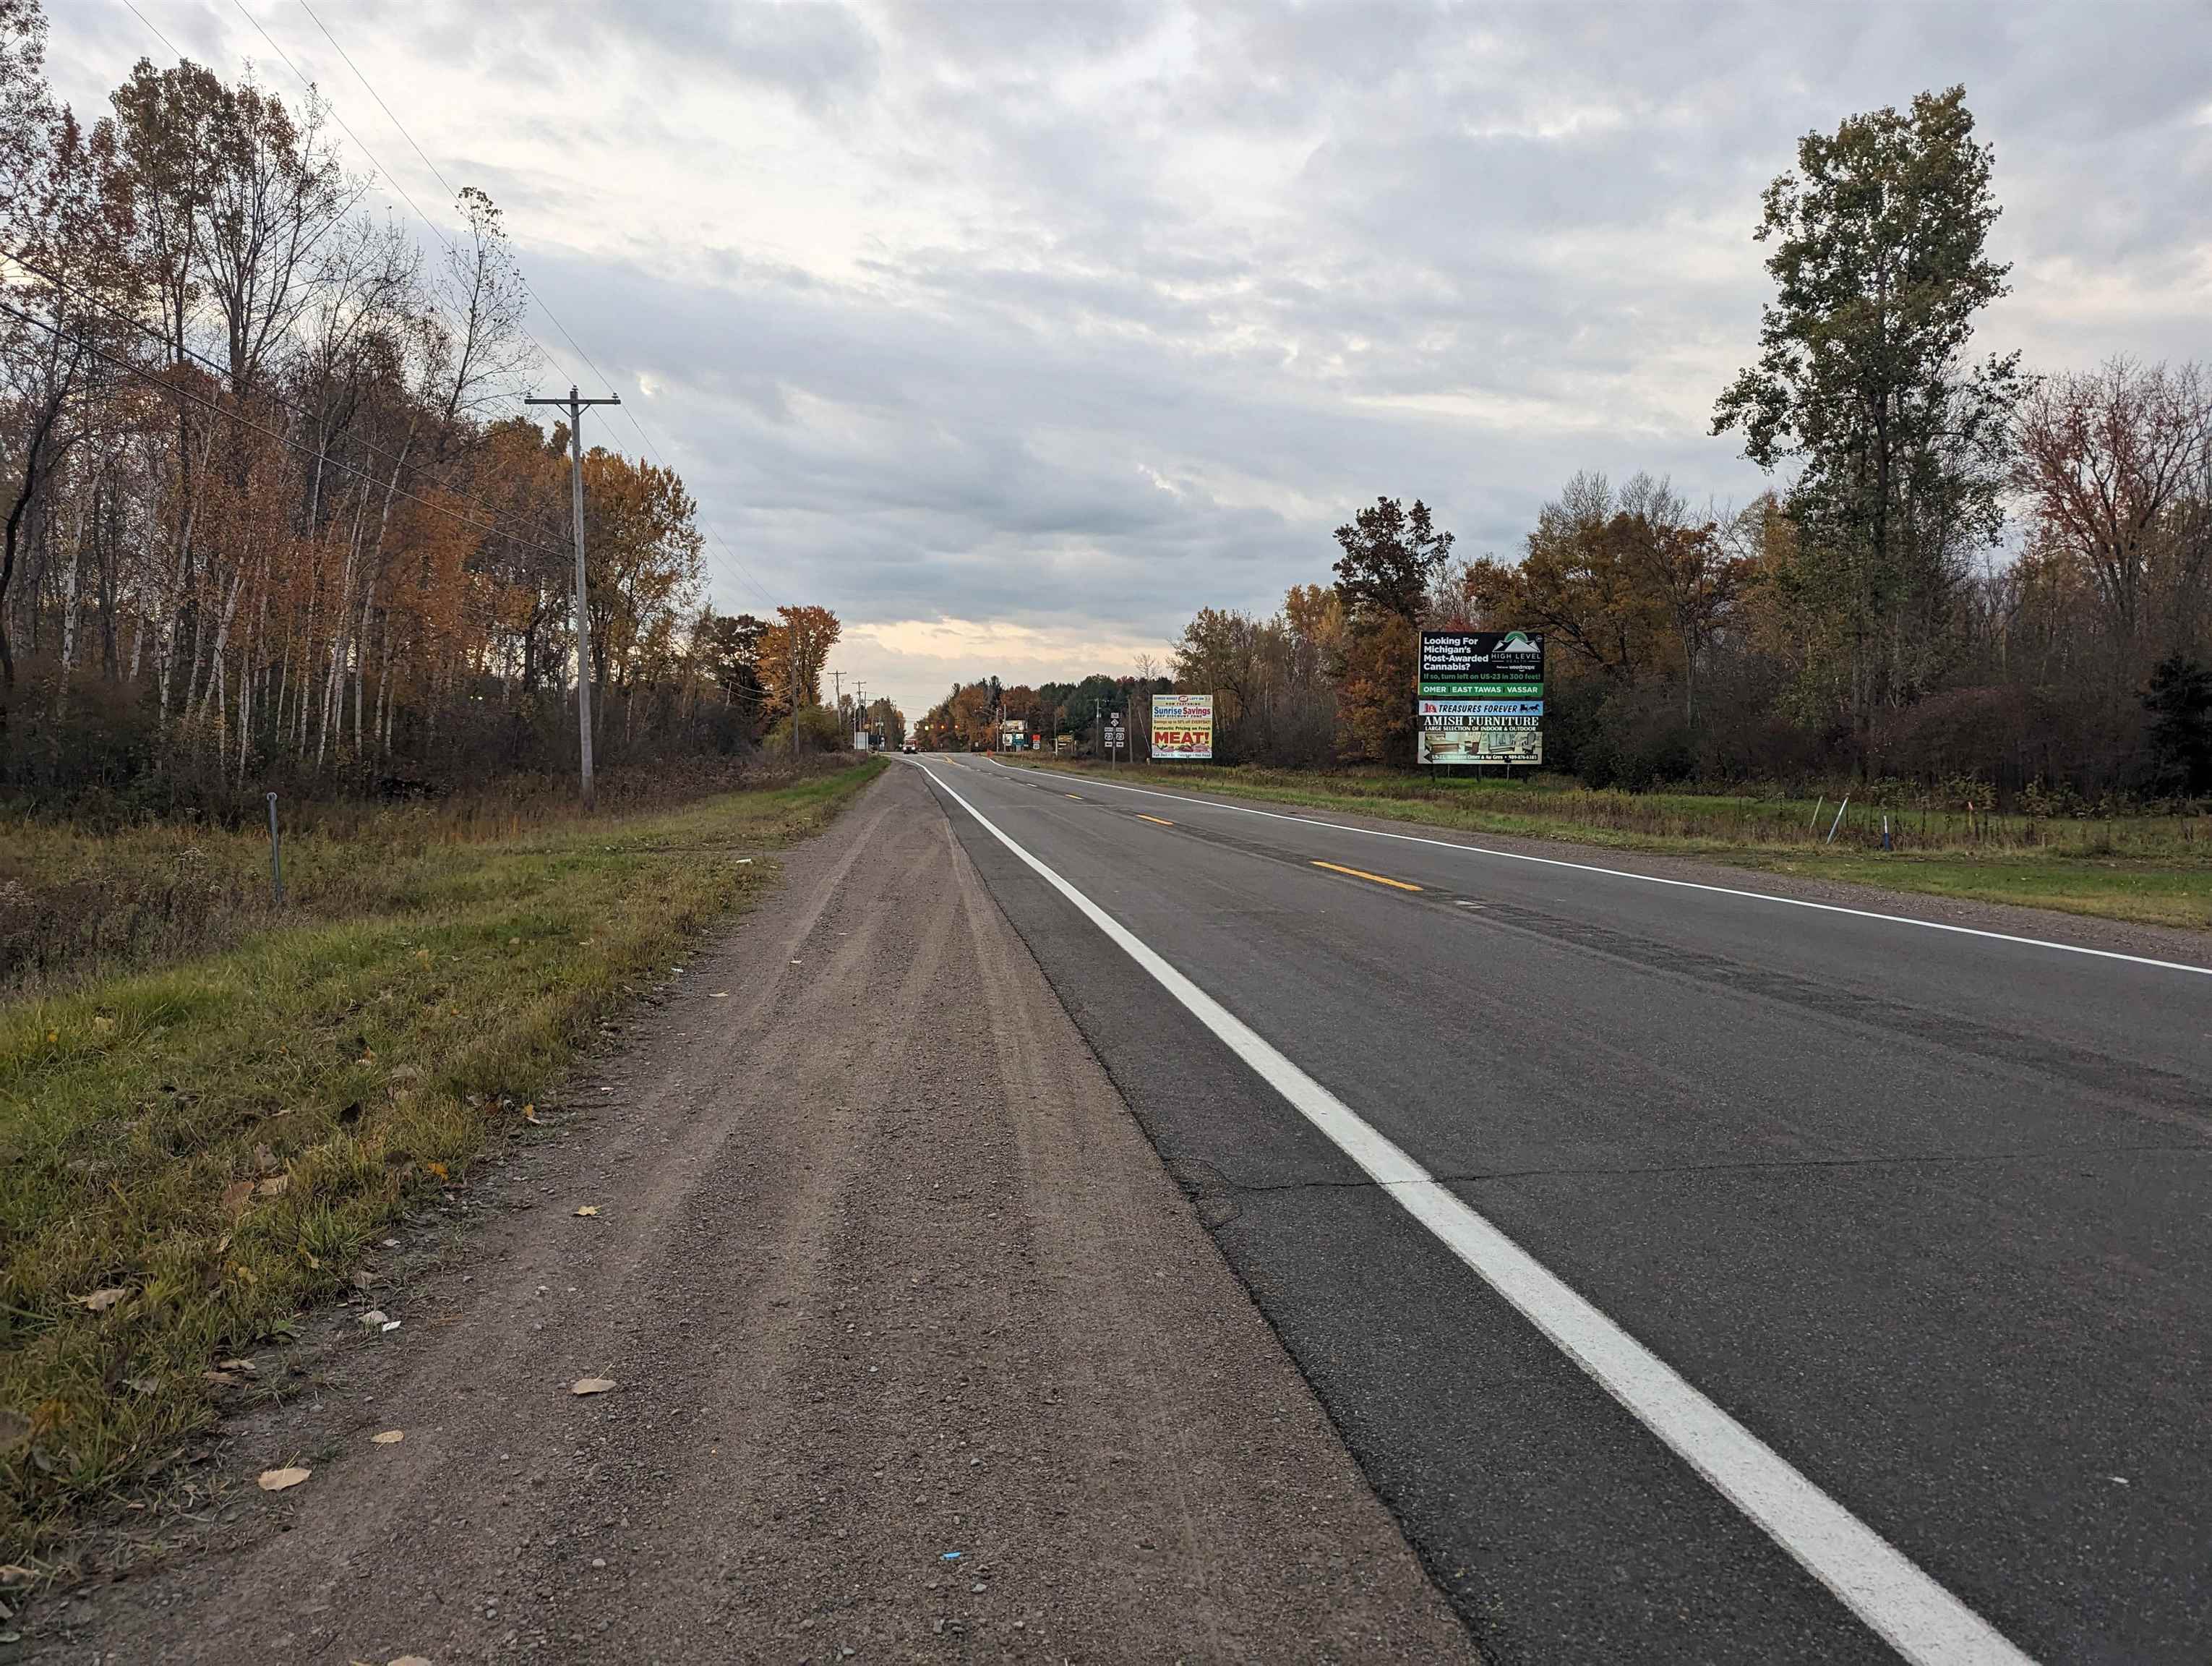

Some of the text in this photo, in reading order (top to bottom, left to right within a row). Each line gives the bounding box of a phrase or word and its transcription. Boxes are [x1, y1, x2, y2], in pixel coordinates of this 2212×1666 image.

[1424, 637, 1461, 646] Looking
[1424, 646, 1471, 654] Michigan's
[1423, 662, 1471, 671] Cannabis?
[1183, 706, 1211, 716] Savings
[1439, 704, 1518, 713] TREASURES FOREVER
[1424, 717, 1539, 726] AMISH FURNITURE
[1154, 732, 1209, 744] MEAT!
